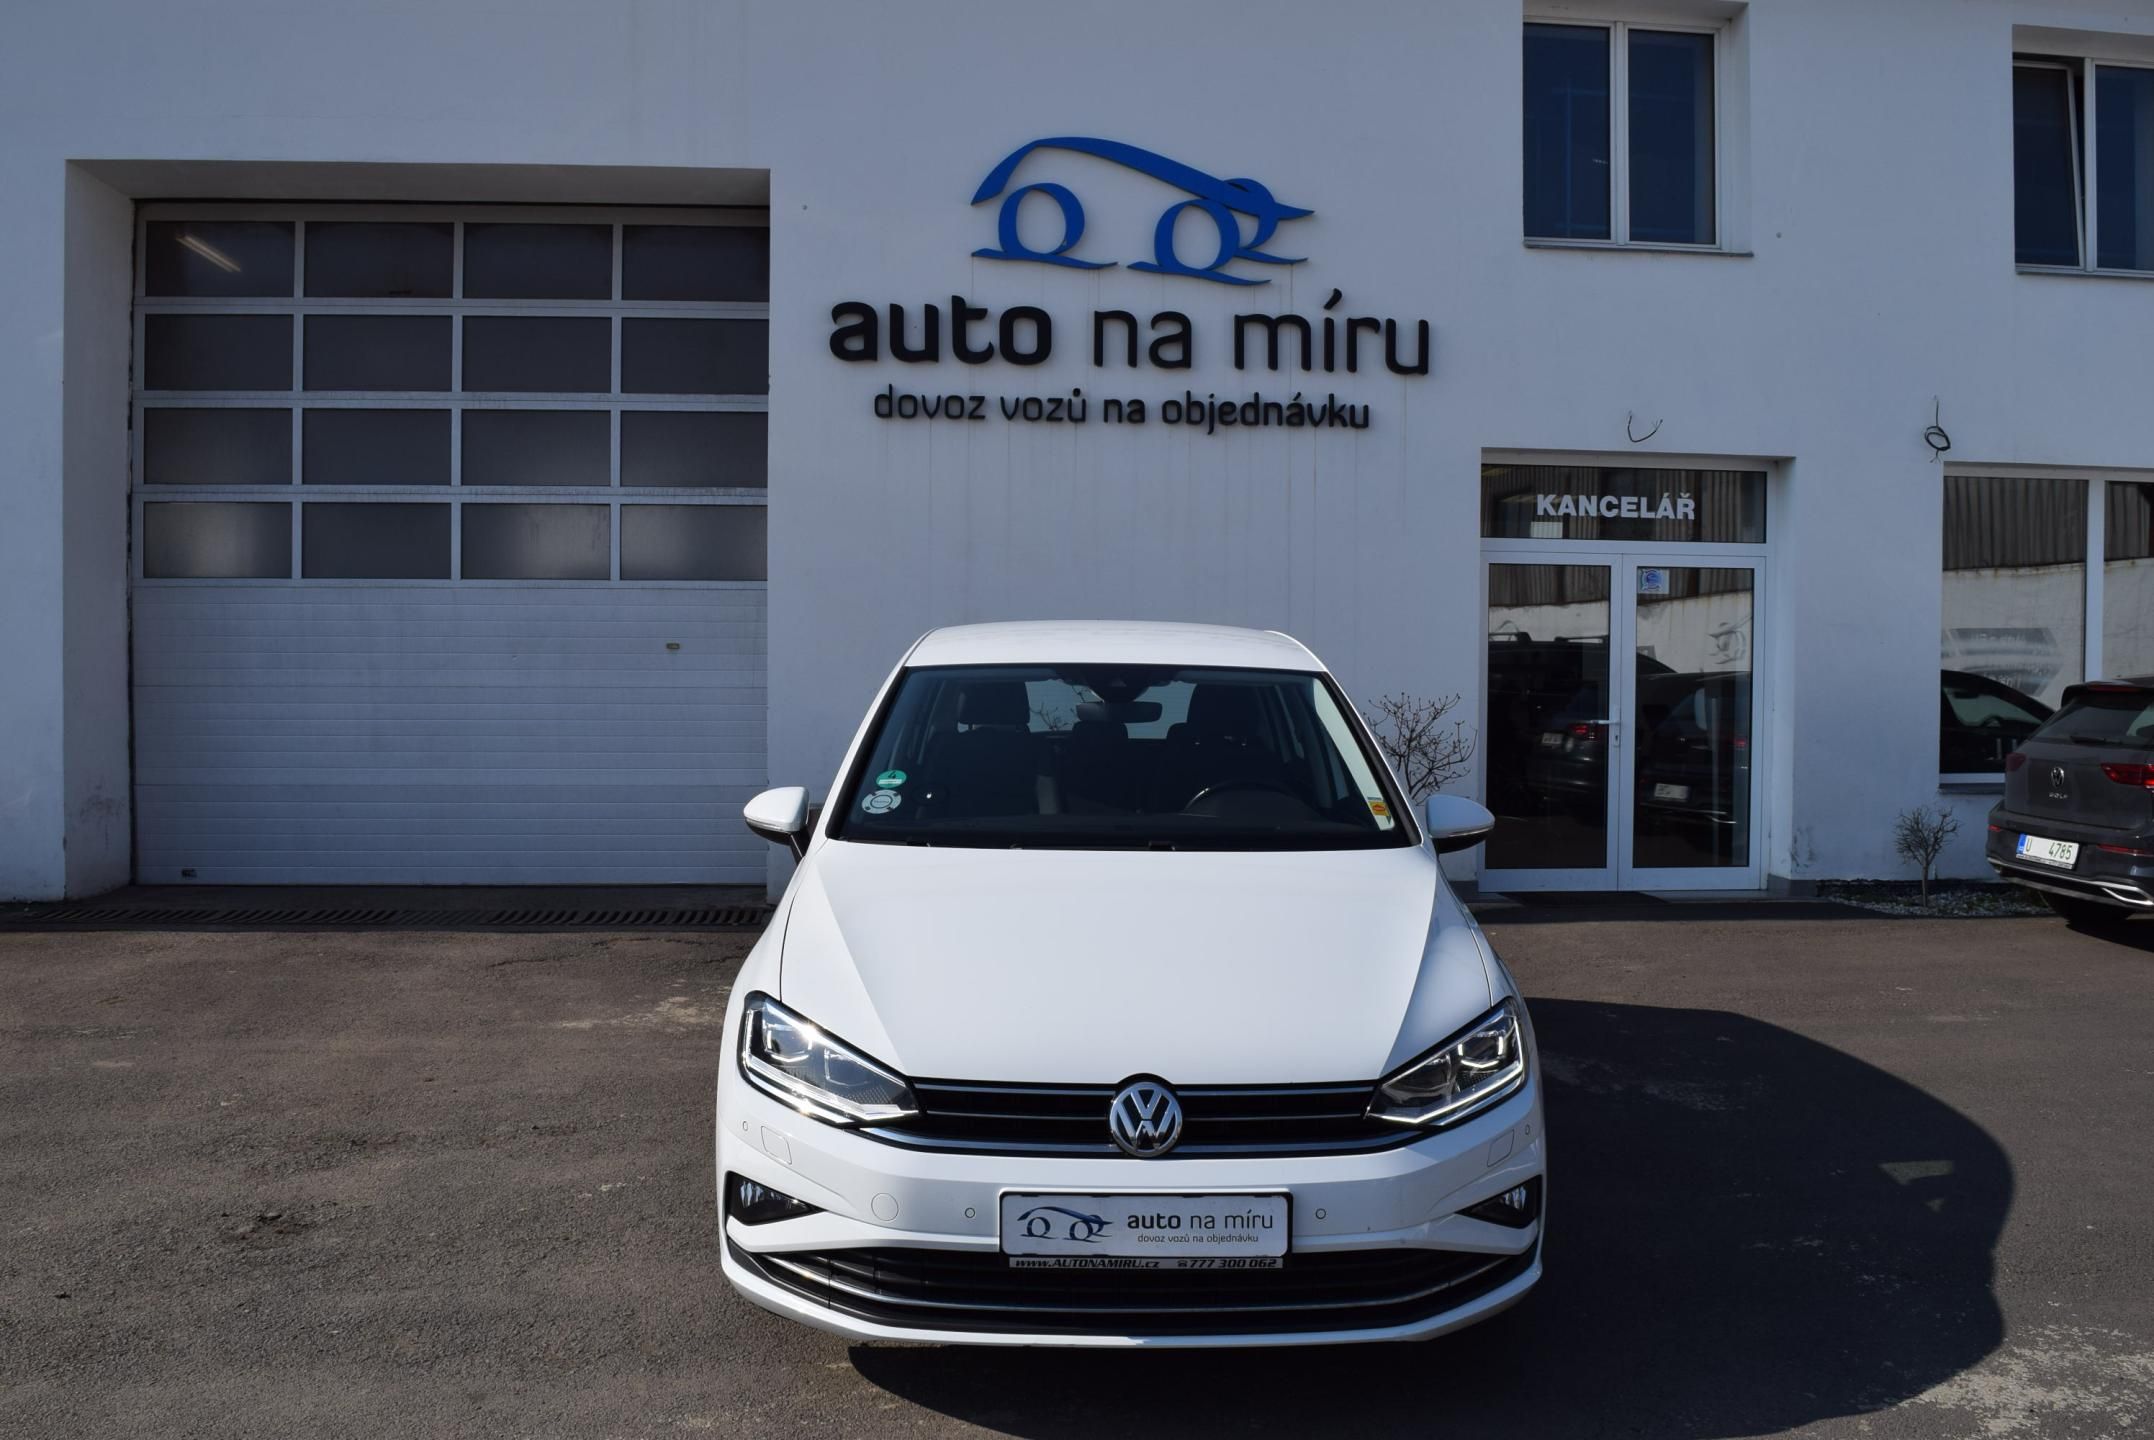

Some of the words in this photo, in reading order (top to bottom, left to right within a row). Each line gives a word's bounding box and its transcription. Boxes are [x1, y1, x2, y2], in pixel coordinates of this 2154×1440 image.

[829, 295, 1053, 366] auto
[1093, 309, 1193, 369] na
[1234, 288, 1430, 376] míru
[873, 383, 987, 421] dovoz
[1000, 388, 1087, 424] vozů
[1103, 398, 1146, 425] na
[1161, 391, 1370, 435] objednávku
[1536, 492, 1696, 520] KANCELÁŘ
[1127, 1212, 1181, 1229] auto
[1190, 1215, 1216, 1229] na
[1224, 1209, 1273, 1229] míru
[1137, 1233, 1166, 1243] dovoz
[1167, 1233, 1190, 1243] vozů
[1192, 1235, 1204, 1243] na
[1206, 1233, 1259, 1245] objednávku
[1015, 1258, 1160, 1268] www.AUTONAMIRU.cz
[1190, 1259, 1215, 1268] 777
[1219, 1259, 1246, 1268] 300
[1249, 1259, 1277, 1268] 062
